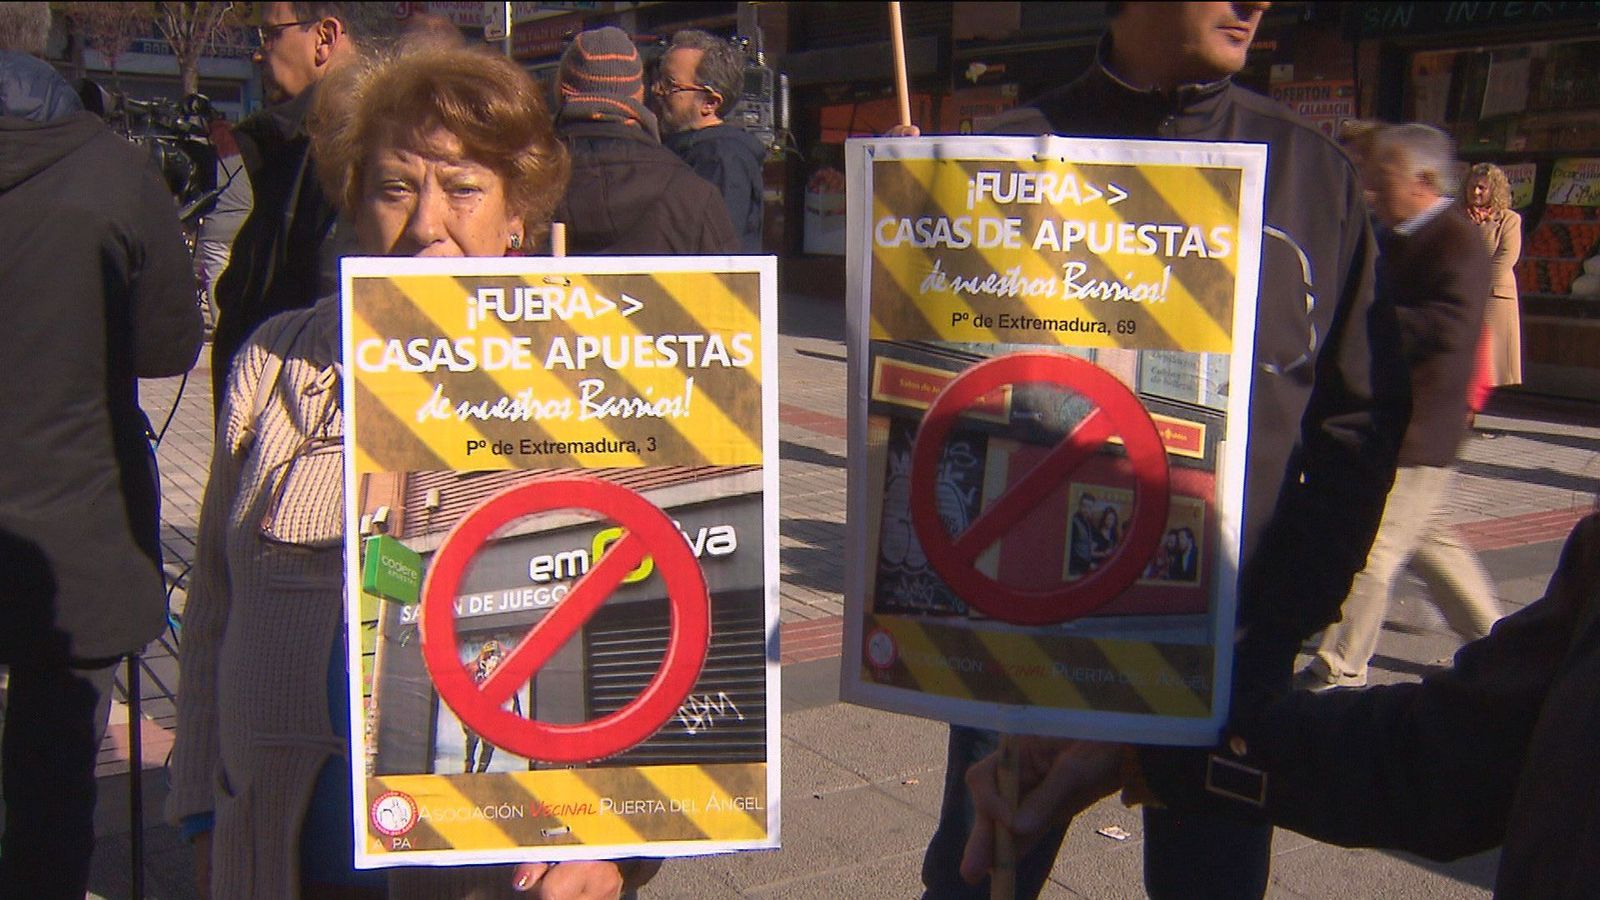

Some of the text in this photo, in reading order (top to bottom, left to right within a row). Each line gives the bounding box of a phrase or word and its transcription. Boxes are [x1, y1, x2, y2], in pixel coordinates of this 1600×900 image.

[875, 216, 1232, 259] CASAS DE APUESTAS
[919, 260, 1172, 304] de nuestros Barrios!
[974, 313, 993, 328] de
[999, 313, 1111, 336] Extremadura,
[1116, 318, 1136, 336] 69
[356, 332, 754, 373] CASAS DE APUESTAS
[416, 377, 694, 423] de nuestros Barrios!
[492, 440, 514, 455] de
[519, 438, 641, 456] Extremadura,
[647, 437, 657, 452] 3
[470, 595, 493, 612] DE
[418, 802, 524, 822] ASOCIACIÓN
[530, 800, 596, 818] VECINAL
[600, 797, 666, 817] PUERTA
[670, 799, 697, 814] DEL
[705, 793, 764, 812] ÁNGEL
